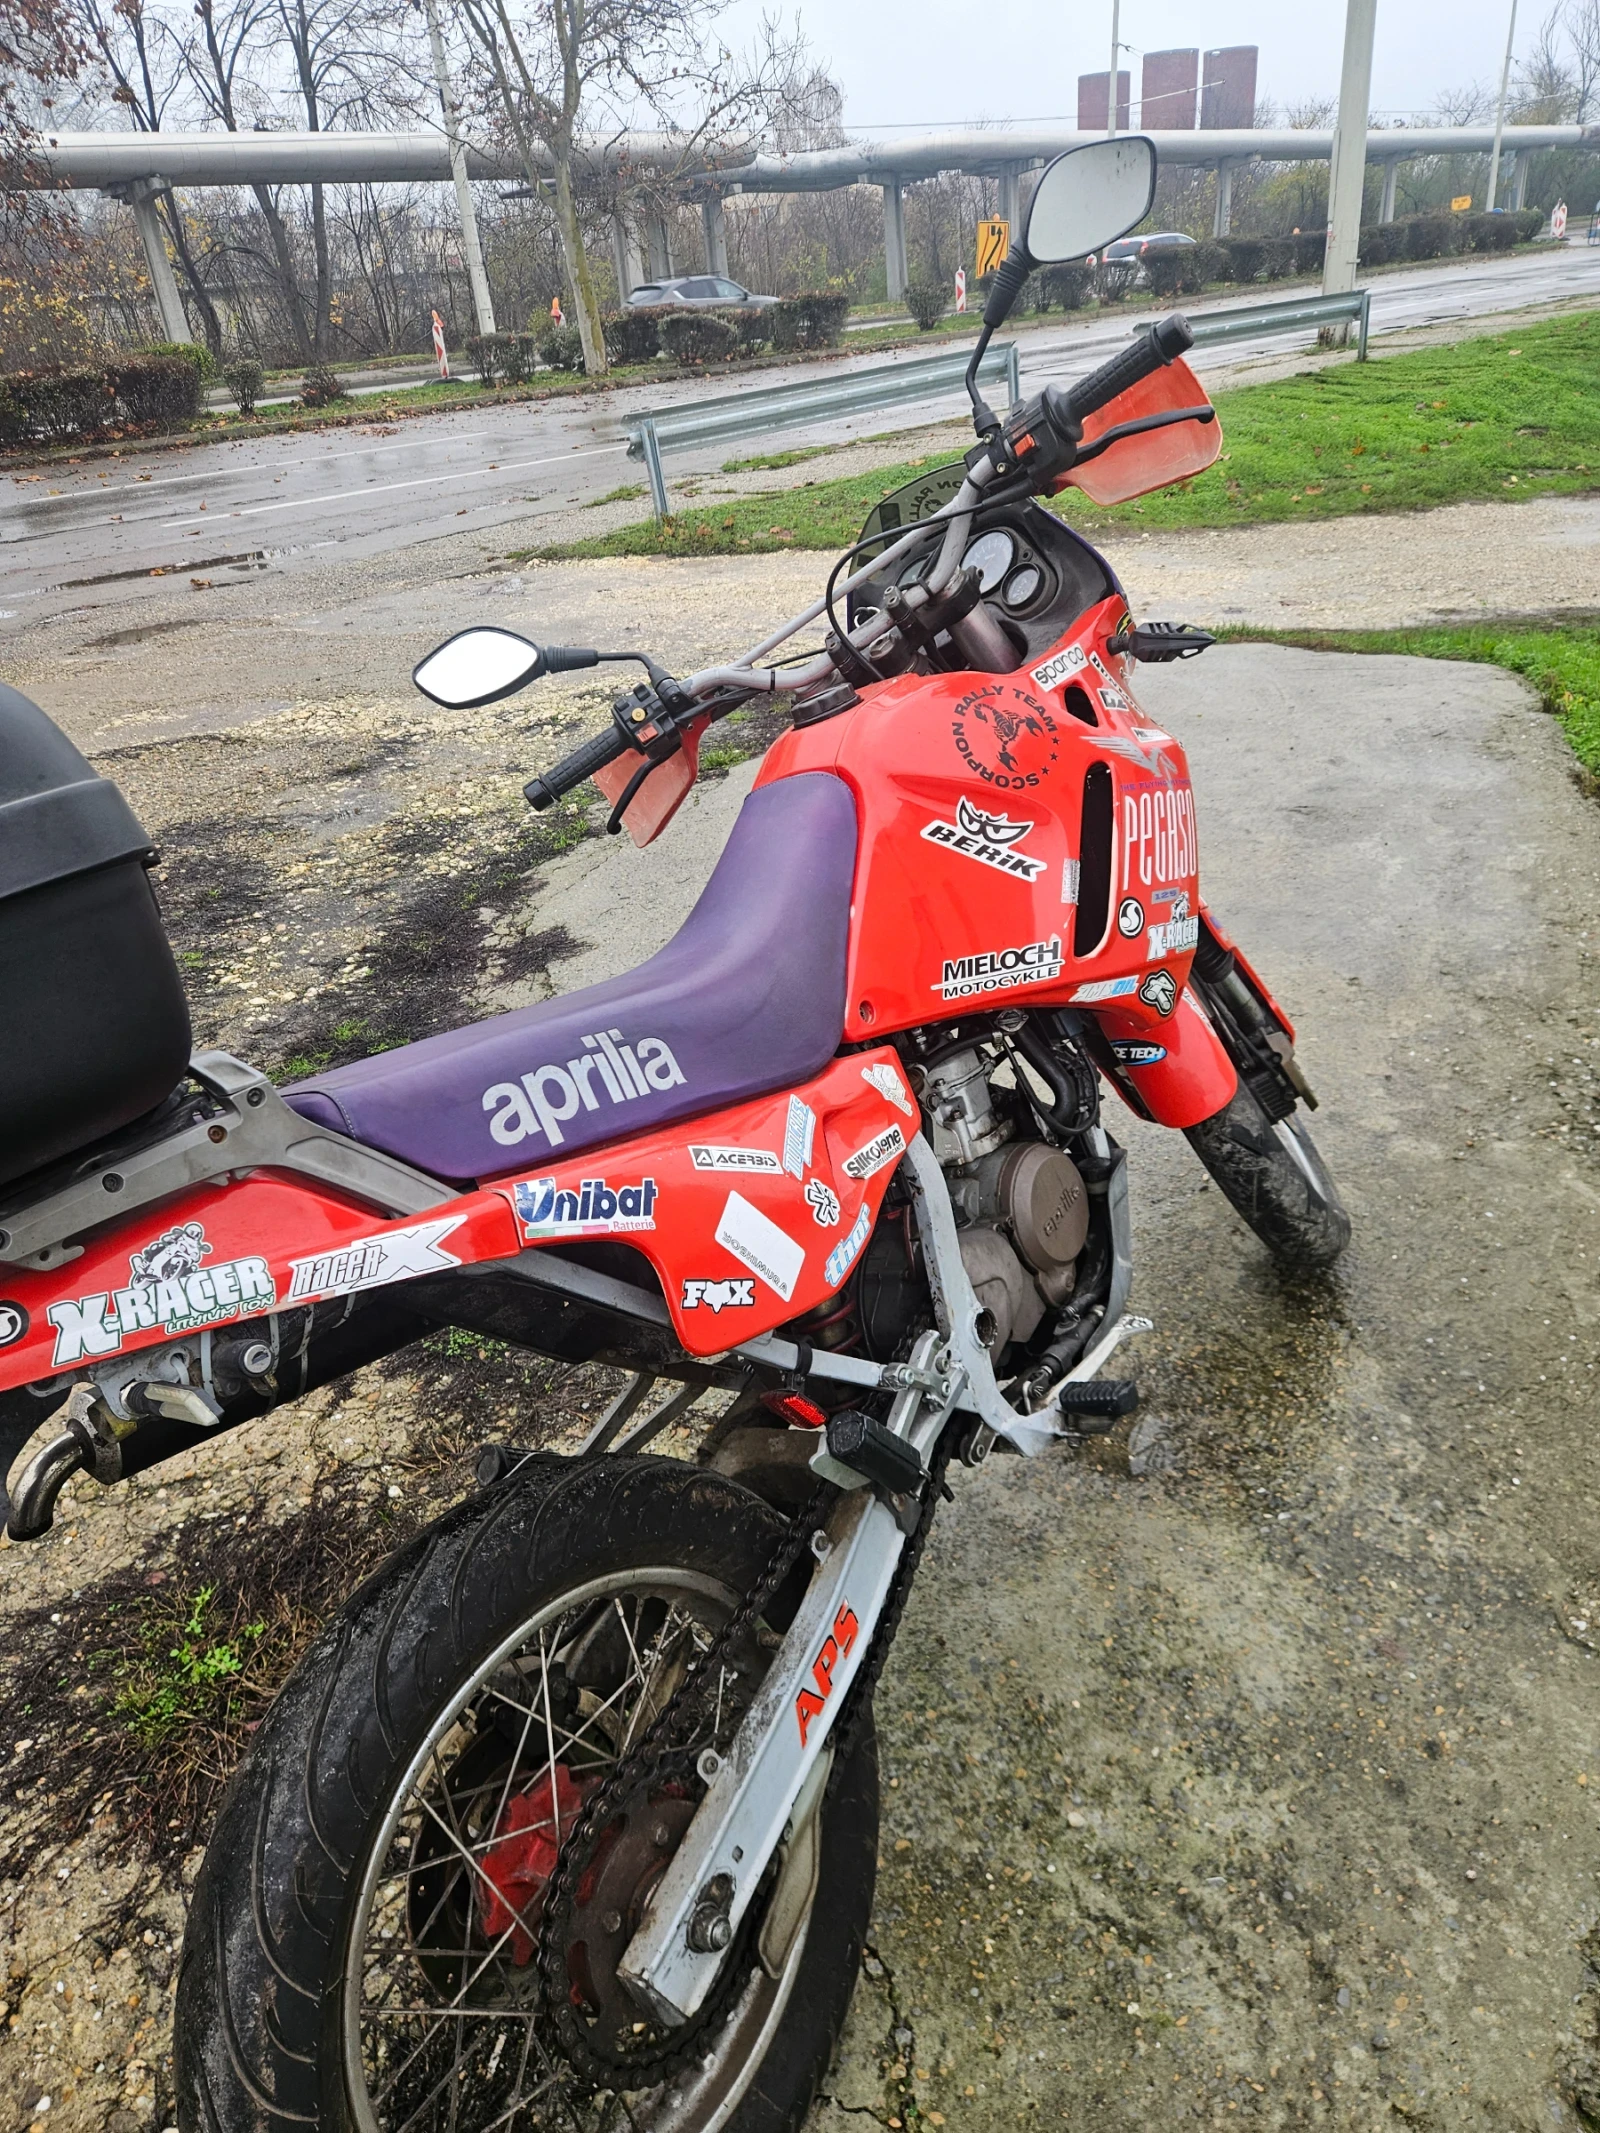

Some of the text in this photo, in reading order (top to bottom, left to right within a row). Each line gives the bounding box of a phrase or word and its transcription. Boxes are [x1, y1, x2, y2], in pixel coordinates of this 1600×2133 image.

[1035, 647, 1084, 685] sparco
[954, 686, 1004, 716] RALLY
[1012, 688, 1058, 732] TEAM
[952, 722, 1040, 789] SCORPION
[1154, 890, 1177, 900] 125
[944, 941, 1060, 981] MIELOCH
[944, 967, 1058, 998] MOTOCYKLE
[1130, 1047, 1164, 1059] TECH
[482, 1028, 688, 1147] aprilia
[846, 1128, 903, 1177] Silkolene
[514, 1177, 657, 1223] Unibat
[612, 1219, 656, 1232] Batterie
[49, 1258, 274, 1366] X-RACER
[166, 1294, 275, 1333] LITHIUM ION
[796, 1597, 859, 1749] APS
